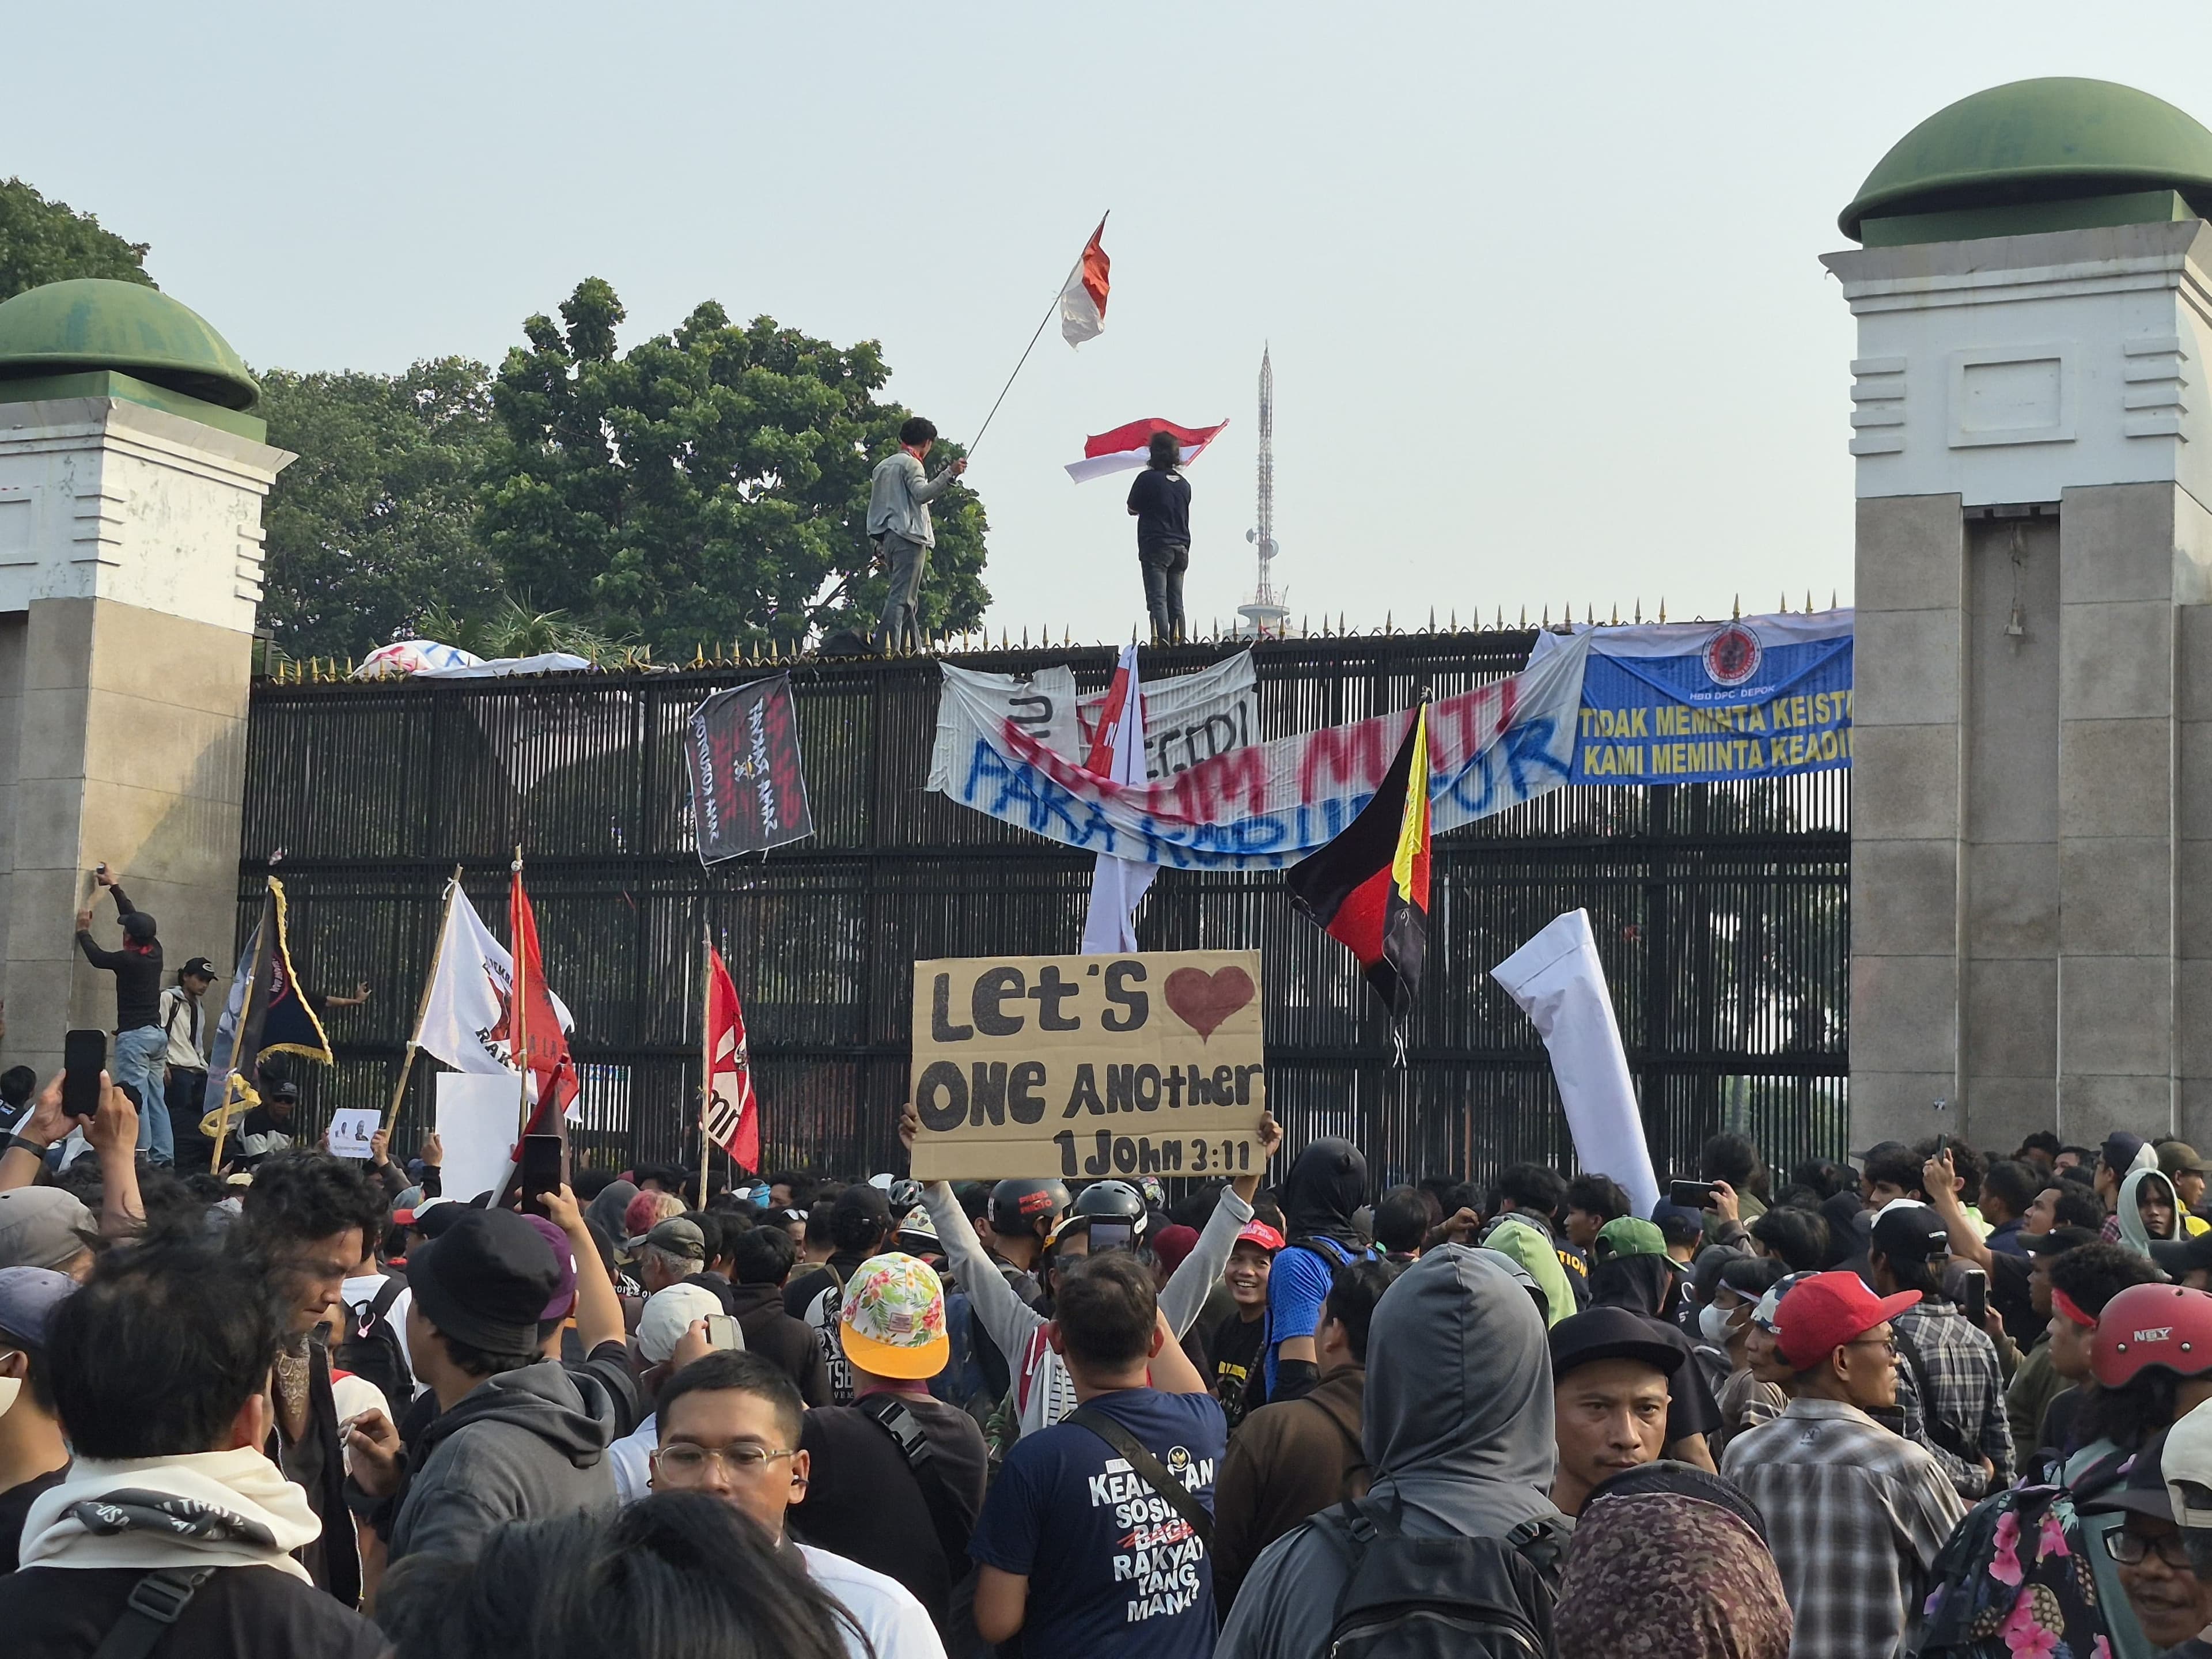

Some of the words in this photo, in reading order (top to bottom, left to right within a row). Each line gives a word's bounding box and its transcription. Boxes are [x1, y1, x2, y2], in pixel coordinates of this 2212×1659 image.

[1714, 690, 1736, 699] DPC
[1740, 685, 1776, 698] DEPOK
[1579, 707, 1649, 738] TIDAK
[1656, 703, 1766, 736] MEMINTA
[1584, 745, 1643, 775] KAMI
[1652, 739, 1765, 774] MEMINTA
[1053, 1129, 1078, 1177] 1
[1191, 1138, 1250, 1172] 3:11
[1138, 1563, 1196, 1596] YANG
